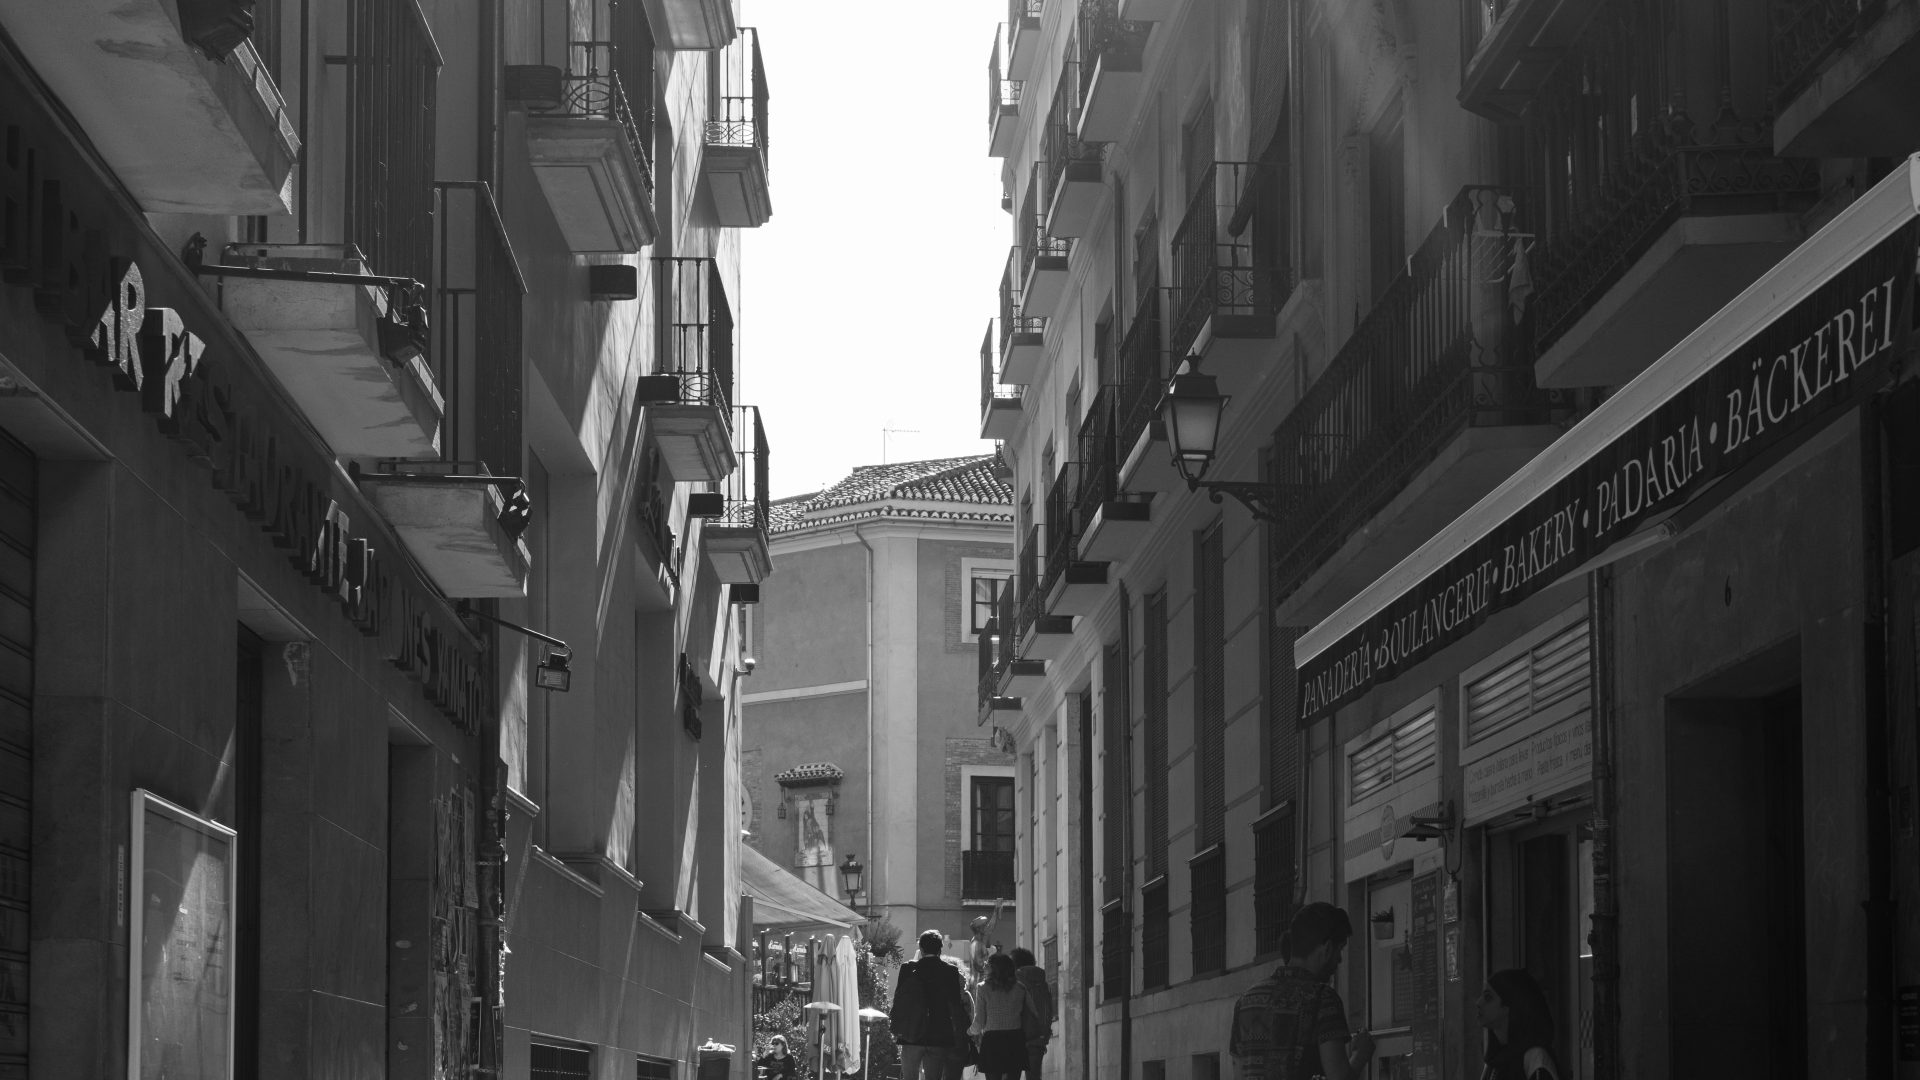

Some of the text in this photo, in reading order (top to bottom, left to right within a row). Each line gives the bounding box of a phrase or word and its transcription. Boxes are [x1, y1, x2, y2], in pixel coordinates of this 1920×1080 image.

[1301, 633, 1371, 719] PANADERÍA
[1501, 499, 1581, 595] BAKERY
[1595, 415, 1704, 538] PADARIA
[1723, 276, 1896, 455] BÄCKEREI
[437, 626, 481, 736] YAMATO
